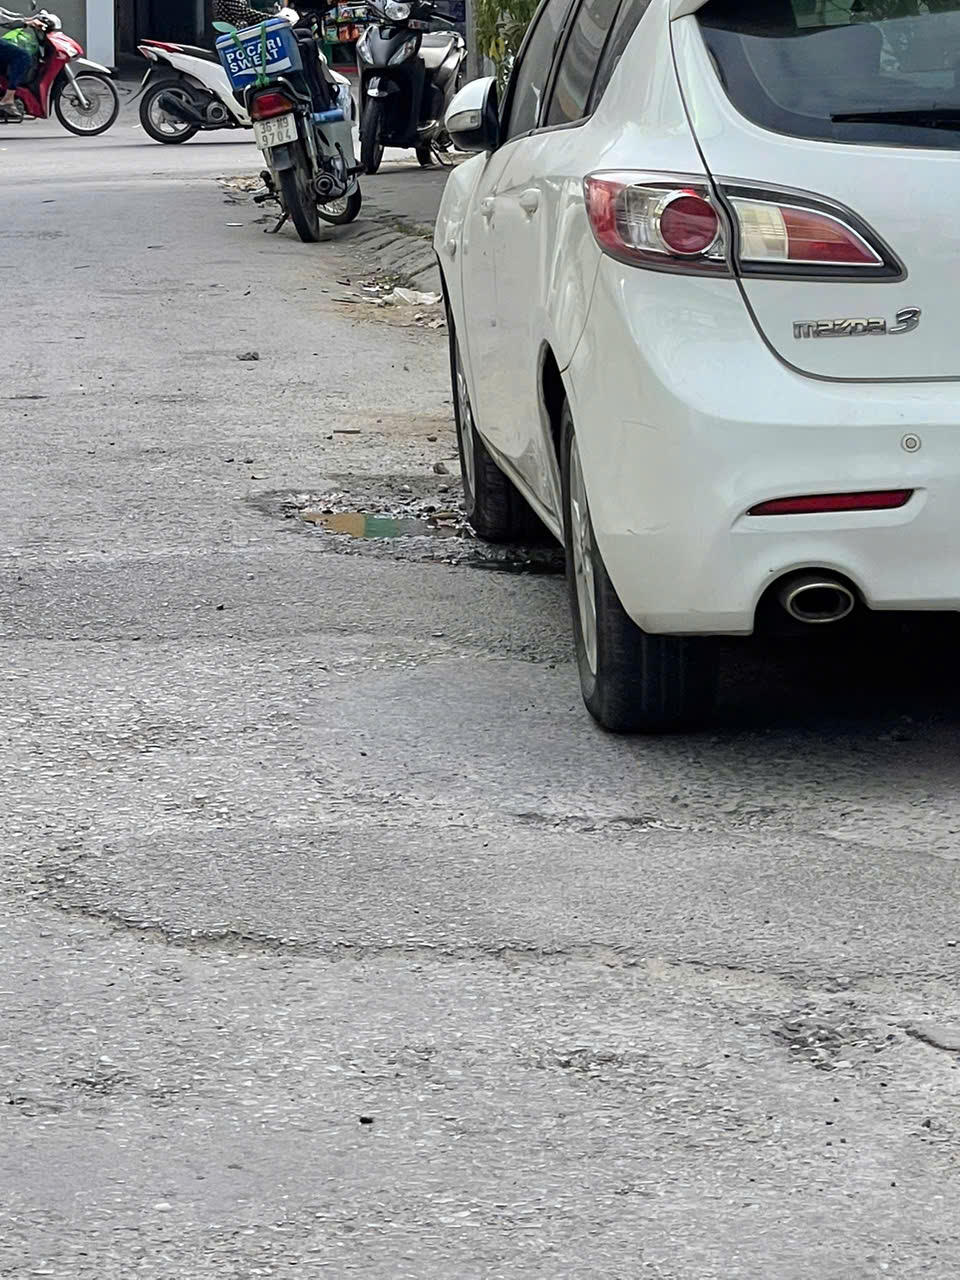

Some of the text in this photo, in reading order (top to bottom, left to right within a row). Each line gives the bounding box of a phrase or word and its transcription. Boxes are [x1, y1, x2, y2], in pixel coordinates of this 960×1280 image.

[226, 36, 282, 64] POCARI
[229, 48, 279, 73] SWEAT
[887, 305, 922, 335] 3
